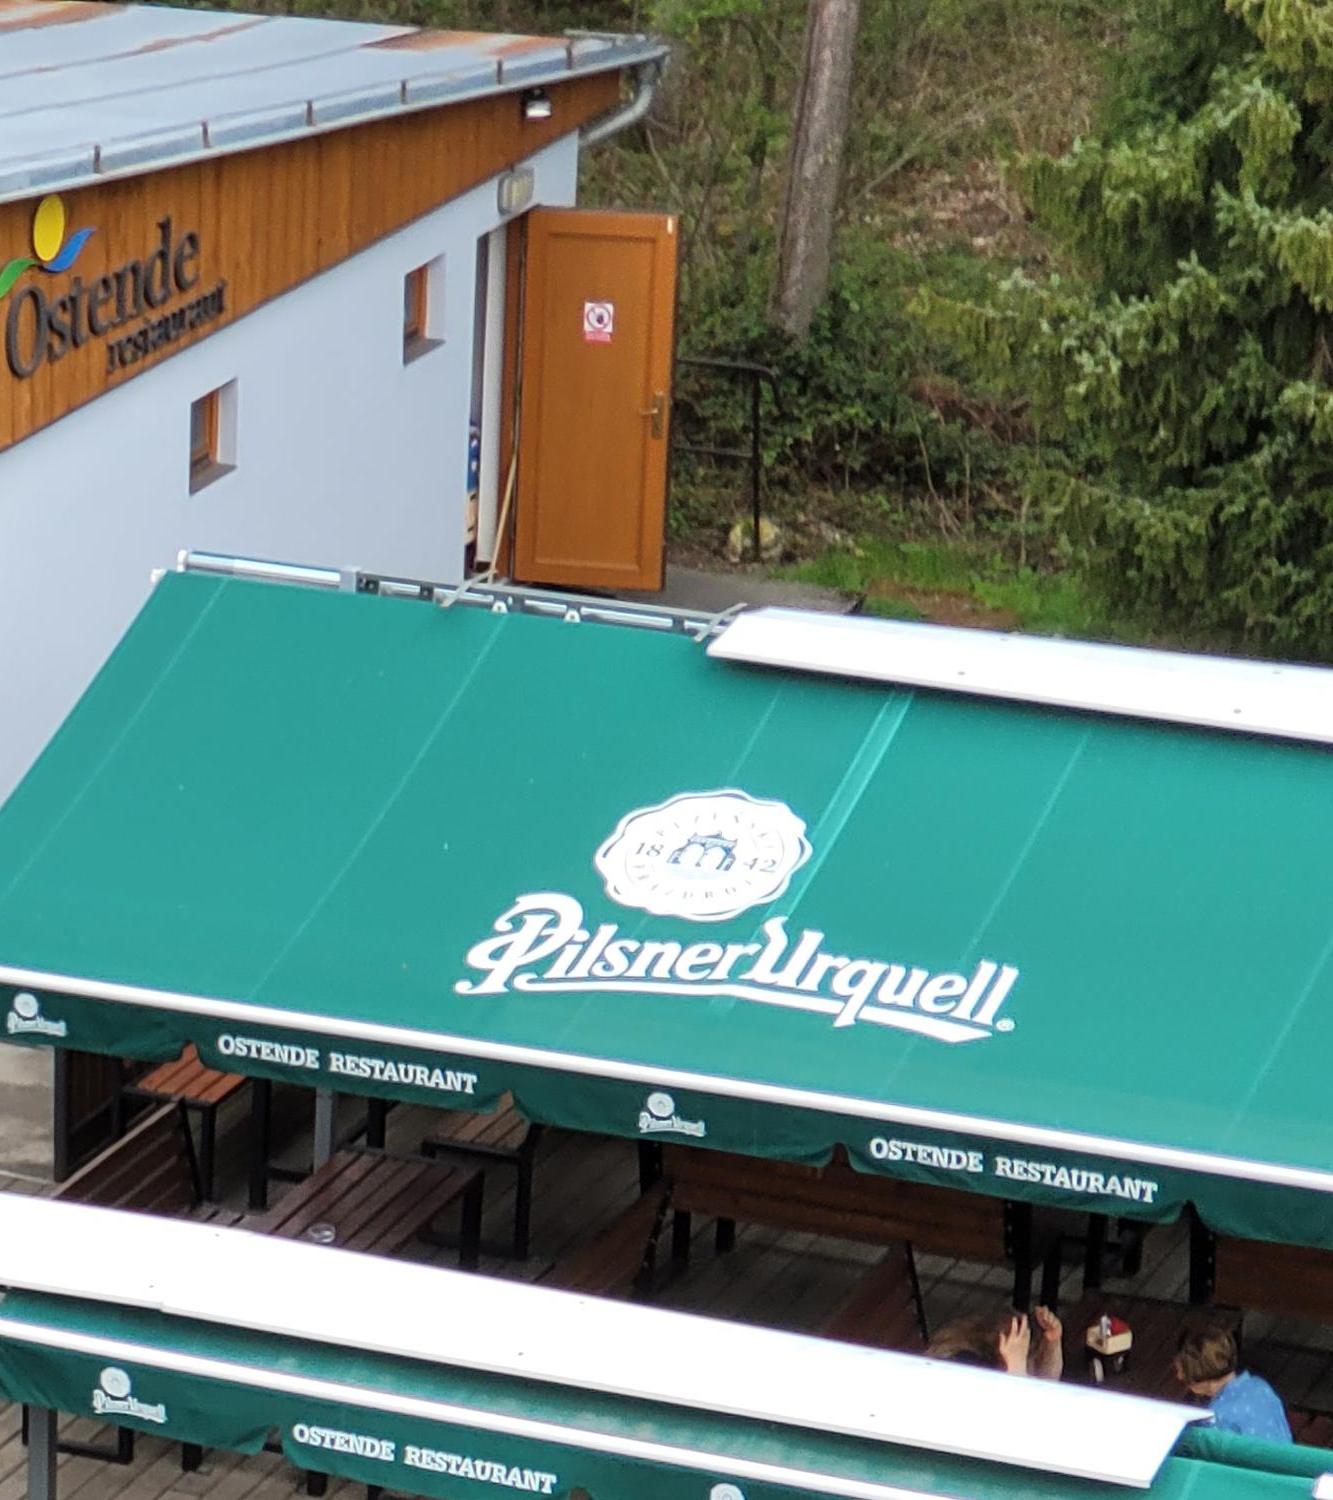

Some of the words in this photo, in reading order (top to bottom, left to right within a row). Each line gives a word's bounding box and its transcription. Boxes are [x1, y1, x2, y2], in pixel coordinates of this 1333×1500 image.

[5, 216, 200, 378] Ostende
[106, 278, 227, 373] restaurant
[634, 842, 665, 857] 18
[454, 892, 770, 995] Pilsner
[745, 915, 1020, 1028] Urquell
[217, 1034, 320, 1069] OSTENDE
[329, 1052, 478, 1094] RESTAURANT
[869, 1137, 983, 1173] OSTENDE
[995, 1156, 1158, 1203] RESTAURANT
[292, 1423, 396, 1462] OSTENDE
[403, 1445, 557, 1494] RESTAURANT
